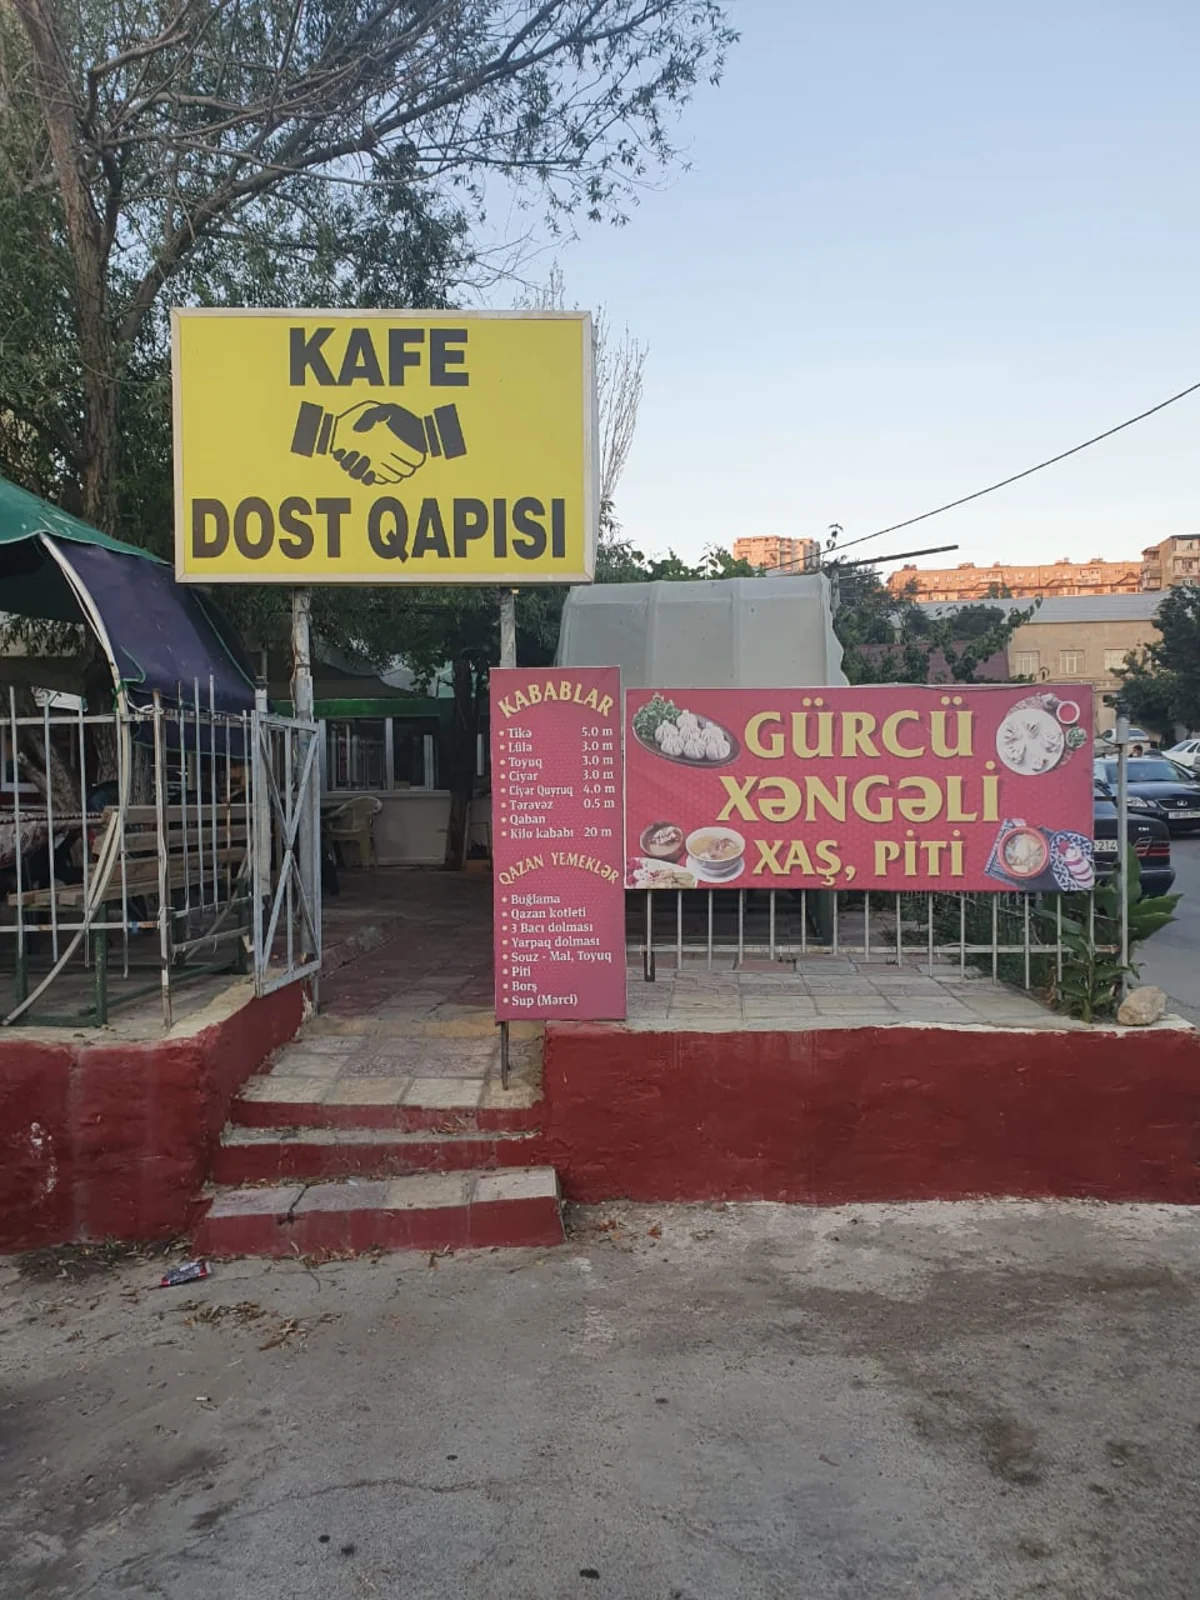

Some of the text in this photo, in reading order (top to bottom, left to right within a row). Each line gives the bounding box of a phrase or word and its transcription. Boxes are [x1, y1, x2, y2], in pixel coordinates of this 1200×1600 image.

[289, 327, 469, 386] KAFE
[192, 496, 565, 563] DOST QAPISI
[498, 680, 614, 718] KABABLAR
[508, 728, 532, 738] Tikə
[582, 727, 598, 736] 5.0
[744, 697, 974, 758] GÜRCÜ
[508, 742, 532, 752] Lülə
[582, 741, 598, 751] 3.0
[508, 756, 613, 769] Toyuq 3.0 m
[509, 771, 538, 782] Ciyər
[582, 770, 599, 779] 3.0
[537, 785, 573, 797] Quyruq
[583, 784, 601, 794] 4.0
[605, 786, 615, 794] m
[717, 761, 1000, 823] XƏNGƏLİ
[510, 800, 553, 810] Tərəvəz
[584, 799, 600, 808] 0.5
[510, 815, 545, 825] Qaban
[510, 828, 532, 839] Kilo
[584, 828, 597, 837] 20
[753, 830, 964, 886] XAŞ, PİTİ
[499, 854, 544, 885] QAZAN
[511, 894, 560, 906] Buğlama
[511, 907, 586, 920] Qazan kotleti
[511, 923, 517, 932] 3
[512, 938, 551, 950] Yarpaq
[512, 952, 539, 962] Souz
[577, 951, 612, 963] Toyuq
[512, 966, 531, 976] Piti
[512, 981, 537, 992] Borş
[512, 995, 534, 1008] Sup
